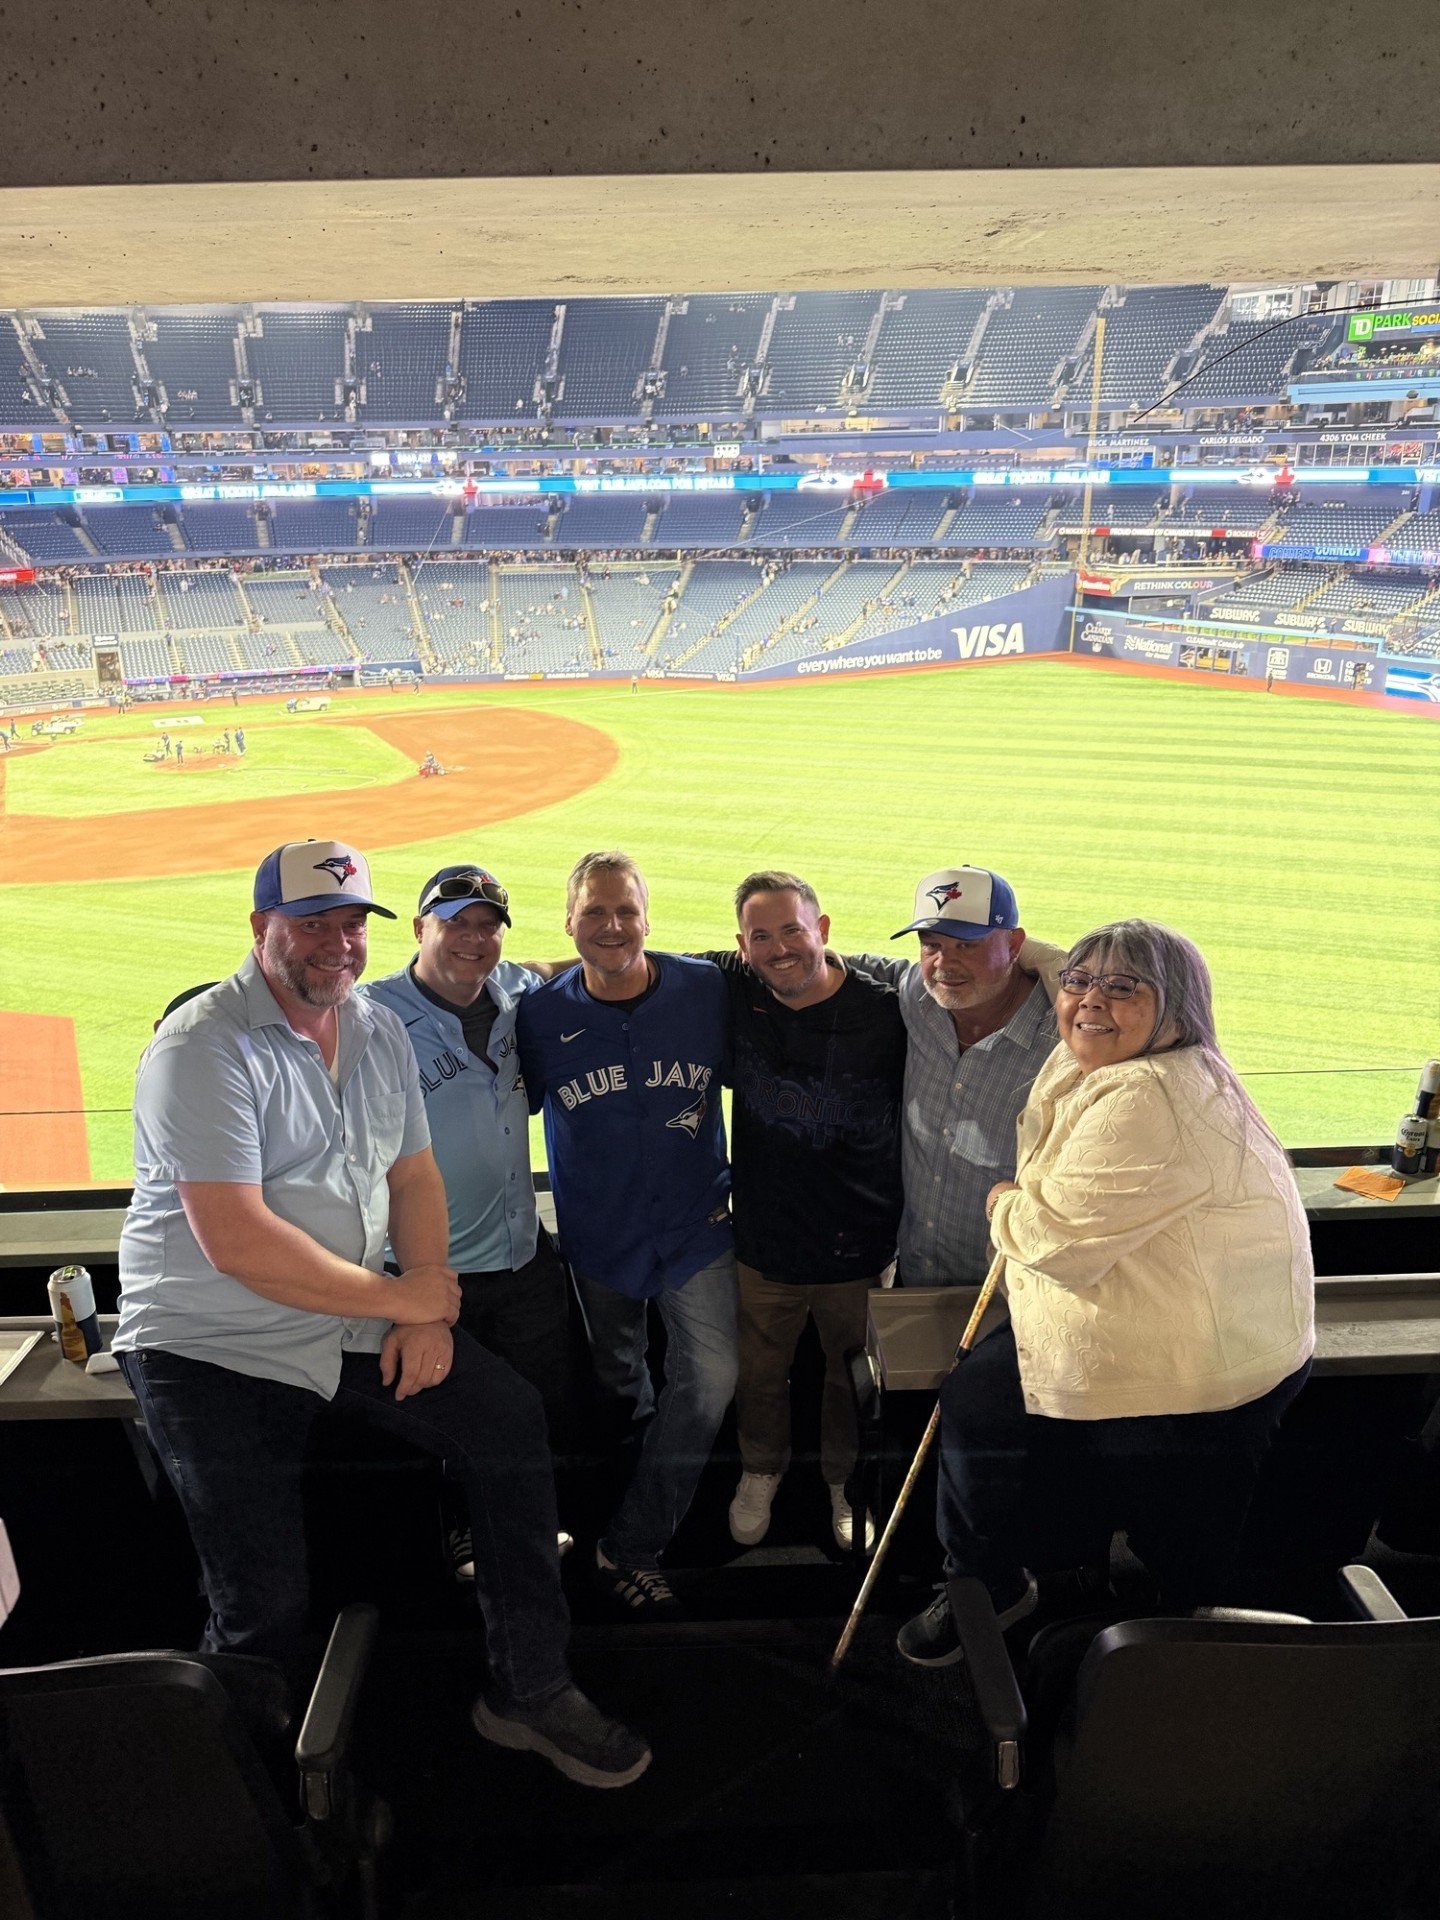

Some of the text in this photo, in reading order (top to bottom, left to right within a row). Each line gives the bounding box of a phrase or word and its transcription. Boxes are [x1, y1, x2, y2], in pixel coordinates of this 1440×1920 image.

[1353, 312, 1440, 336] TD PARK SOCI
[1110, 438, 1150, 446] MARTINEZ
[1200, 435, 1265, 445] CARLOS DELGADO
[1320, 432, 1387, 442] 4306 TOM CHEEK
[1134, 579, 1213, 590] RETHINK COLOUR
[1209, 607, 1257, 622] SUBWAY
[1274, 613, 1325, 629] SUBWAY
[1342, 619, 1391, 635] SUBWAY
[950, 622, 1025, 659] VISA
[1136, 637, 1173, 655] National
[797, 647, 943, 673] everywhere you want to be
[716, 673, 735, 682] VISA
[557, 1060, 713, 1112] BLUE JAYS
